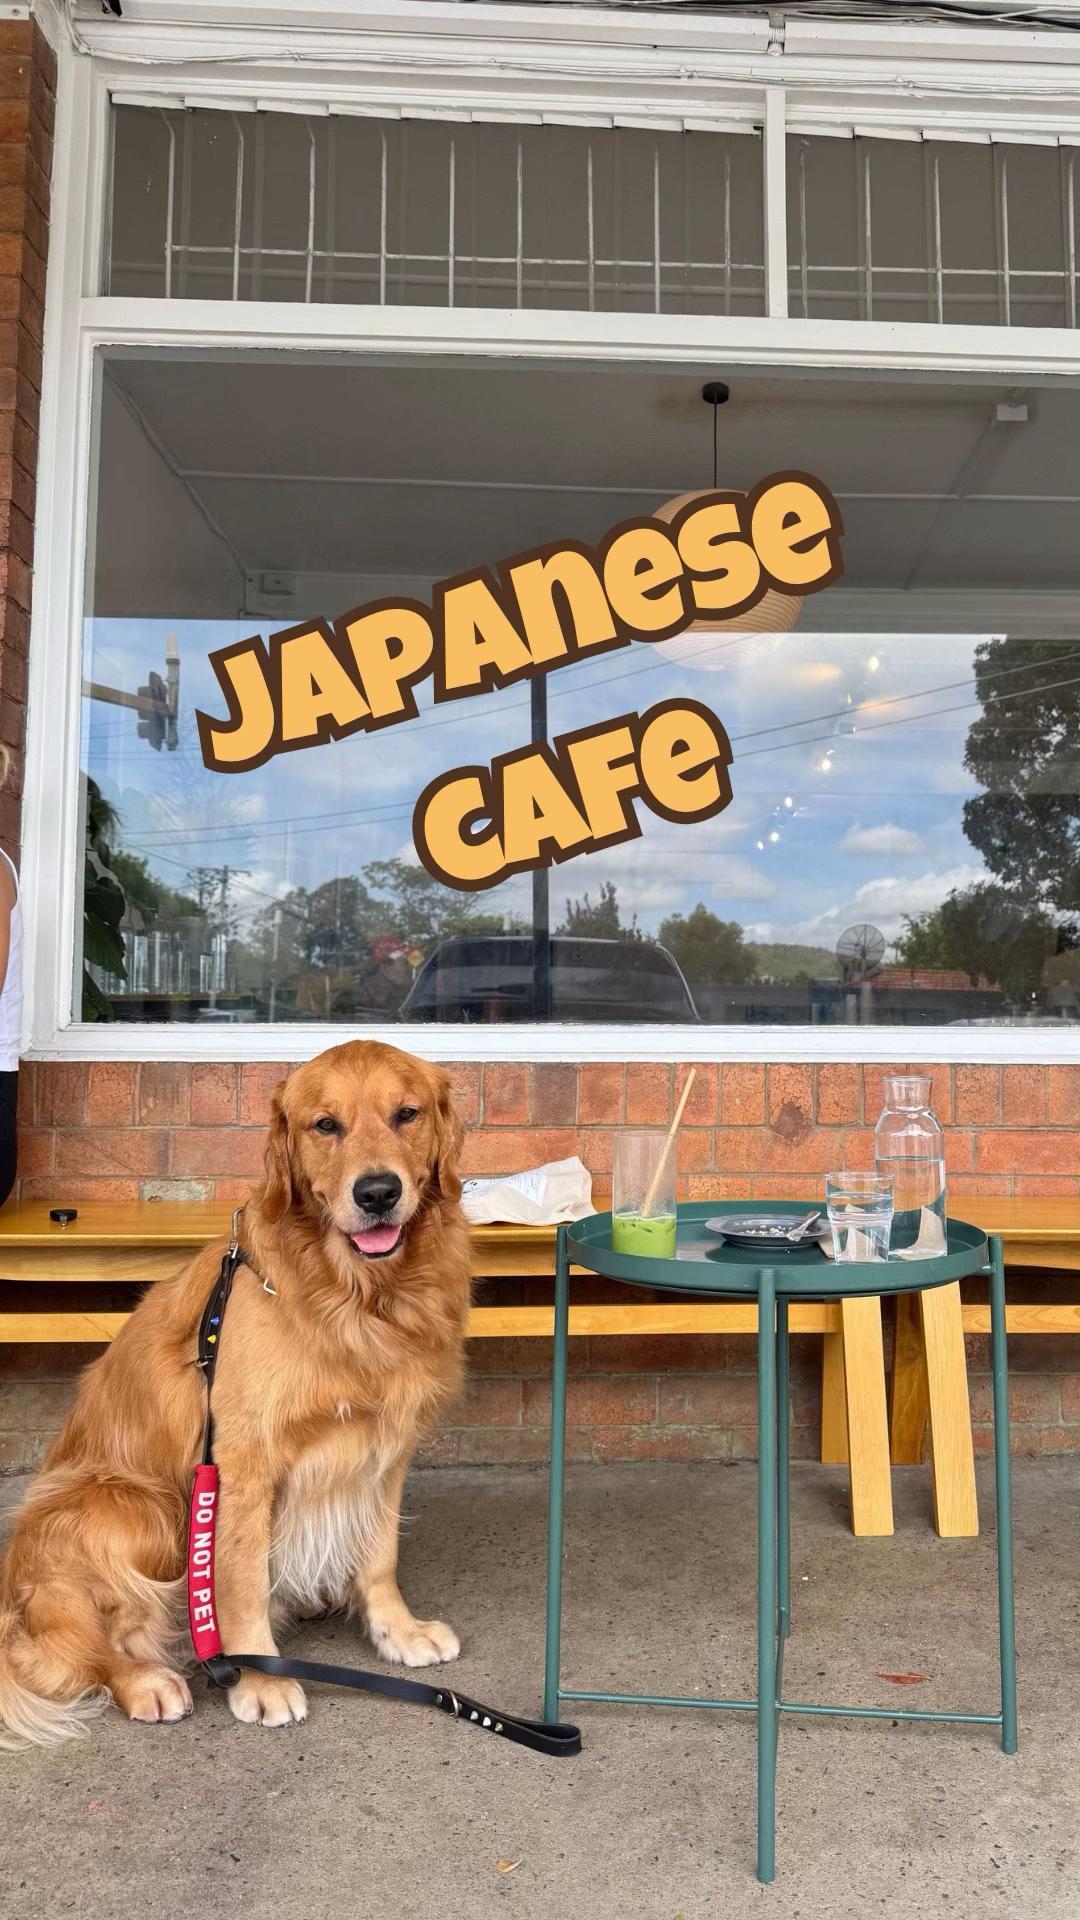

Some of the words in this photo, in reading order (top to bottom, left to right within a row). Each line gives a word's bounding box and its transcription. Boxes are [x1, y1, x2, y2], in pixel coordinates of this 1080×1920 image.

[196, 1491, 216, 1524] DO
[192, 1531, 212, 1579] NOT
[192, 1587, 216, 1633] PET
